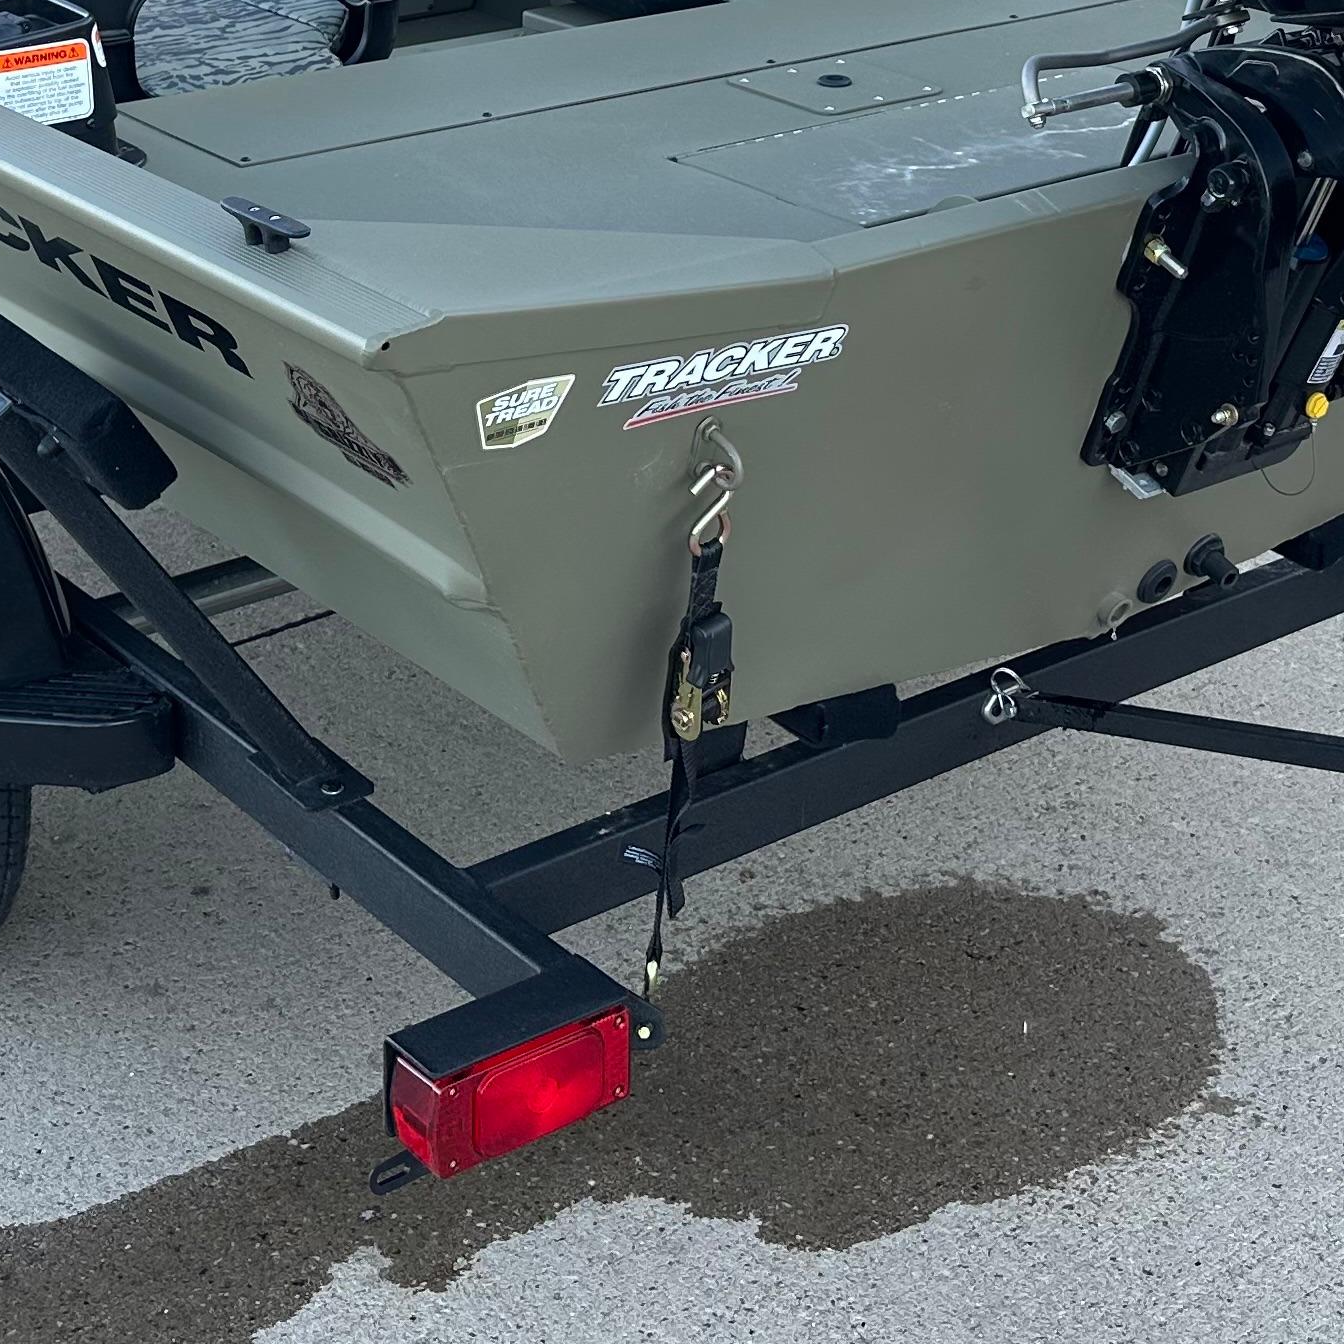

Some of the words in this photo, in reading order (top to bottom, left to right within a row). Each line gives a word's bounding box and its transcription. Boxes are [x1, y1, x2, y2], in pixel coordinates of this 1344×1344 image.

[14, 49, 68, 66] WARNING
[601, 326, 847, 405] TRACKER
[484, 396, 559, 427] TREAD
[491, 382, 558, 412] SURE
